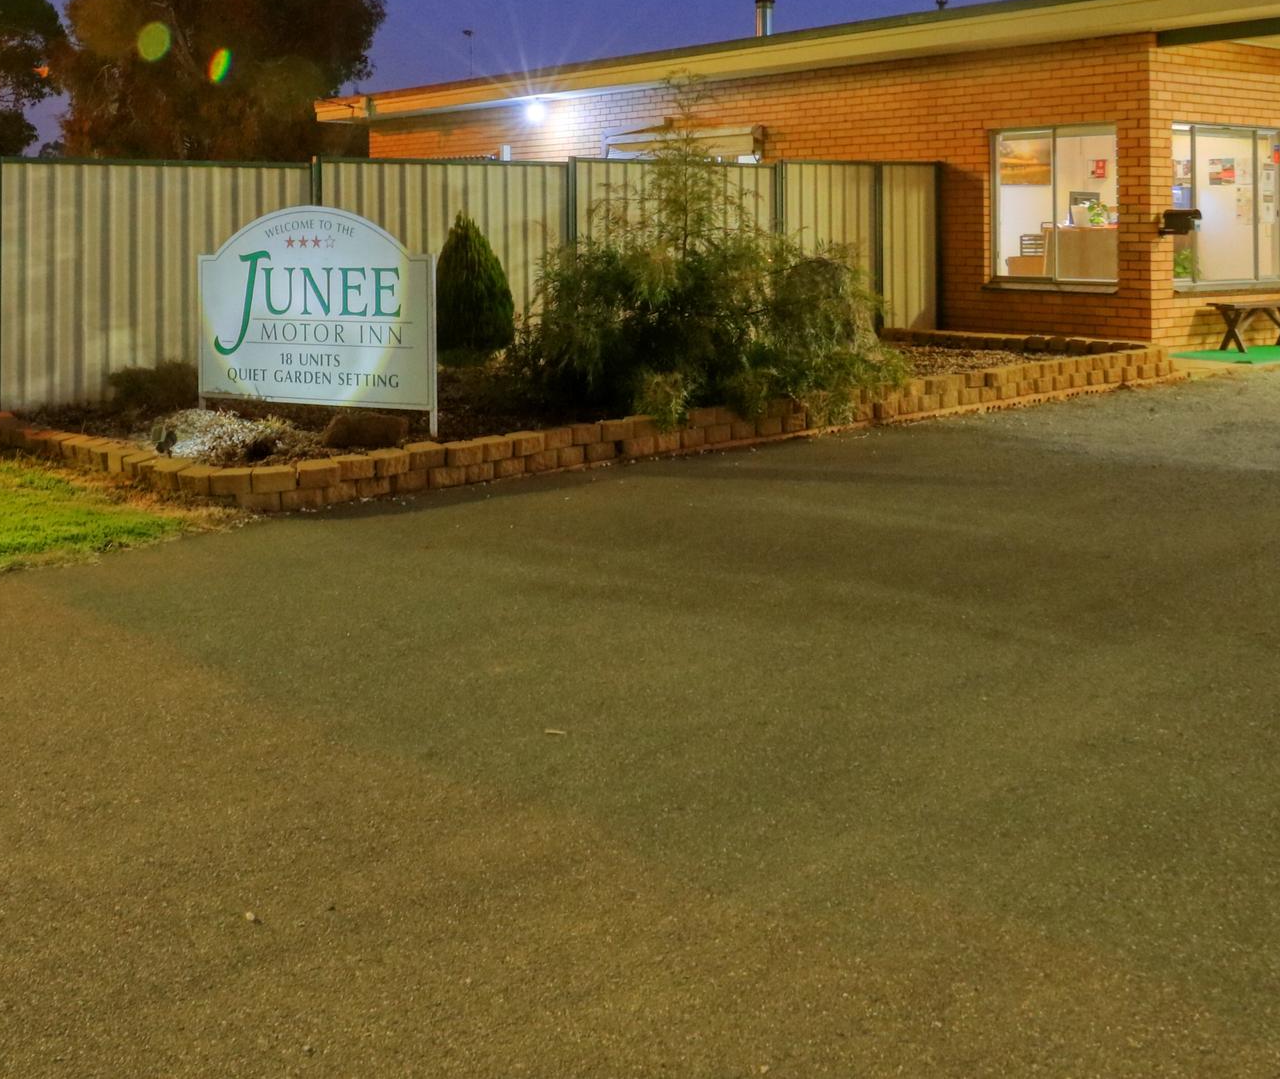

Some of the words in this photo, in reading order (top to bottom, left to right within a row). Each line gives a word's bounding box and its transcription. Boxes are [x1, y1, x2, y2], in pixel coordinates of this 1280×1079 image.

[264, 219, 314, 239] WELCOME
[320, 219, 332, 231] TO
[336, 222, 356, 238] THE
[214, 250, 402, 356] JUNEE
[260, 322, 345, 344] MOTOR
[360, 324, 402, 346] INN
[280, 352, 293, 366] 18
[299, 353, 340, 368] UNITS
[227, 368, 267, 383] QUIET
[274, 369, 332, 385] GARDEN
[338, 372, 399, 389] SETTING
